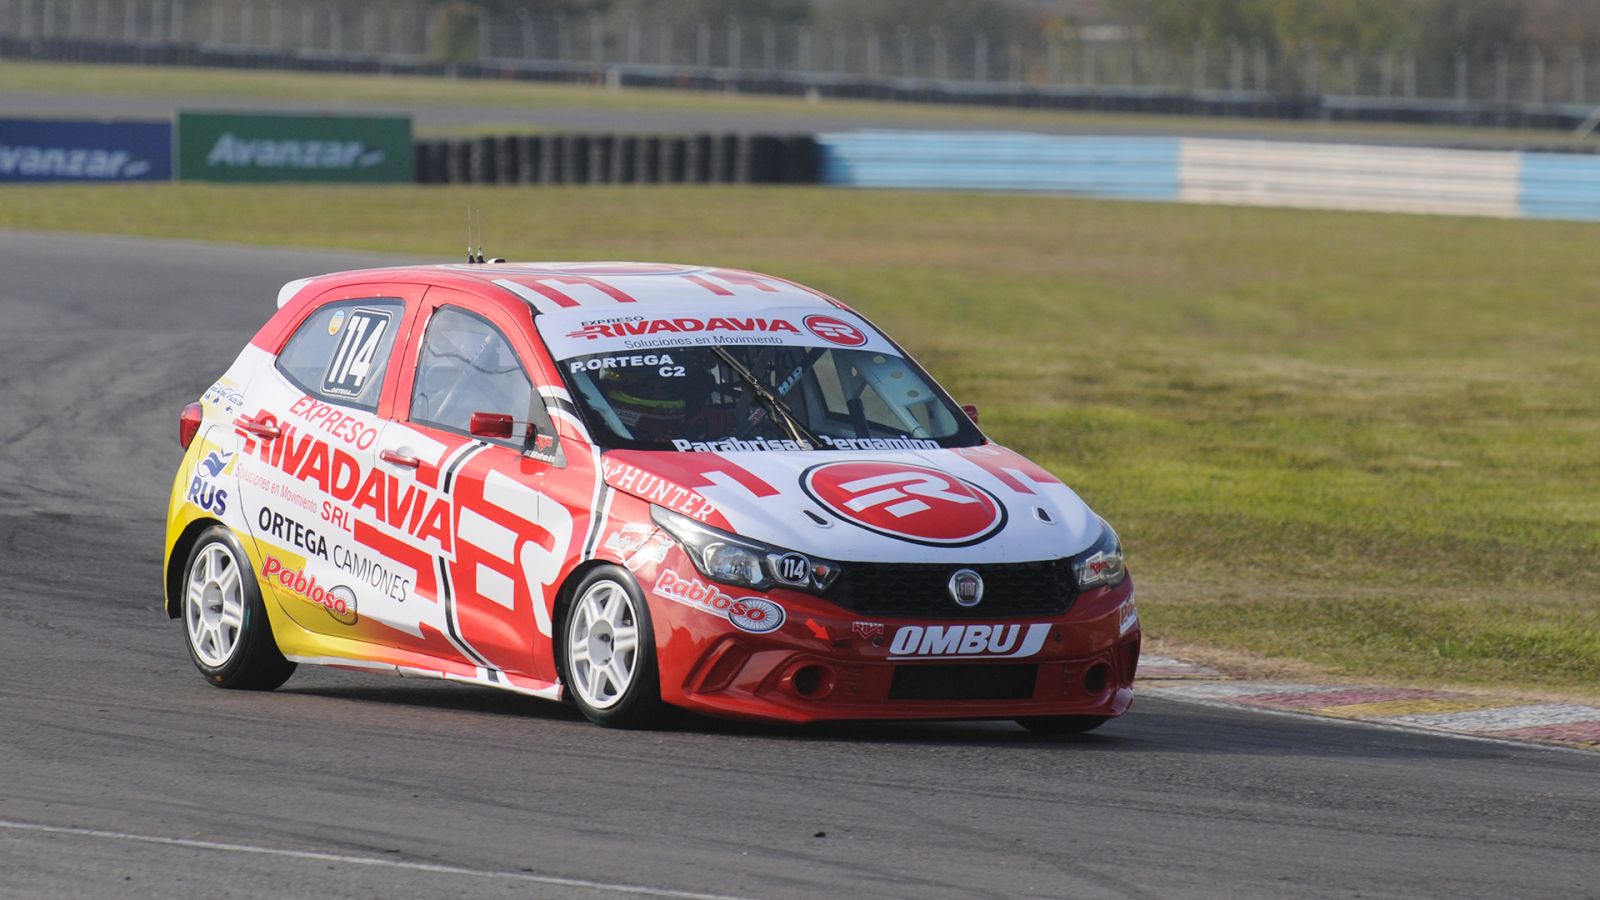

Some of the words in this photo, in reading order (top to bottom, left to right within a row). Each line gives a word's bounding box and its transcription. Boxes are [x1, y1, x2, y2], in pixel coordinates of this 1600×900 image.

[0, 144, 127, 178] vanzar
[206, 132, 360, 168] Avanzar
[567, 317, 802, 340] RIVADAVIA
[580, 316, 645, 327] EXPRESO
[328, 315, 387, 387] 114
[624, 339, 692, 350] Soluciones
[694, 338, 710, 347] en
[713, 334, 783, 345] Movimiento
[570, 354, 674, 374] P.ORTEGA
[658, 365, 686, 377] C2
[289, 396, 379, 451] EXPRESO
[671, 436, 814, 452] Parabrisas
[188, 475, 229, 516] RUS
[233, 408, 453, 554] RIVADAVIA
[235, 463, 271, 491] Soluciones
[271, 483, 280, 494] en
[281, 484, 318, 514] Movimiento
[617, 465, 716, 522] HUNTER
[321, 500, 352, 532] SRL
[258, 506, 329, 561] ORTEGA
[333, 544, 410, 603] CAMIONES
[783, 558, 805, 579] 114
[261, 553, 348, 616] Pabloso
[656, 570, 767, 622] Pabloso
[960, 582, 976, 597] FIAT
[889, 623, 1021, 655] OMBU
